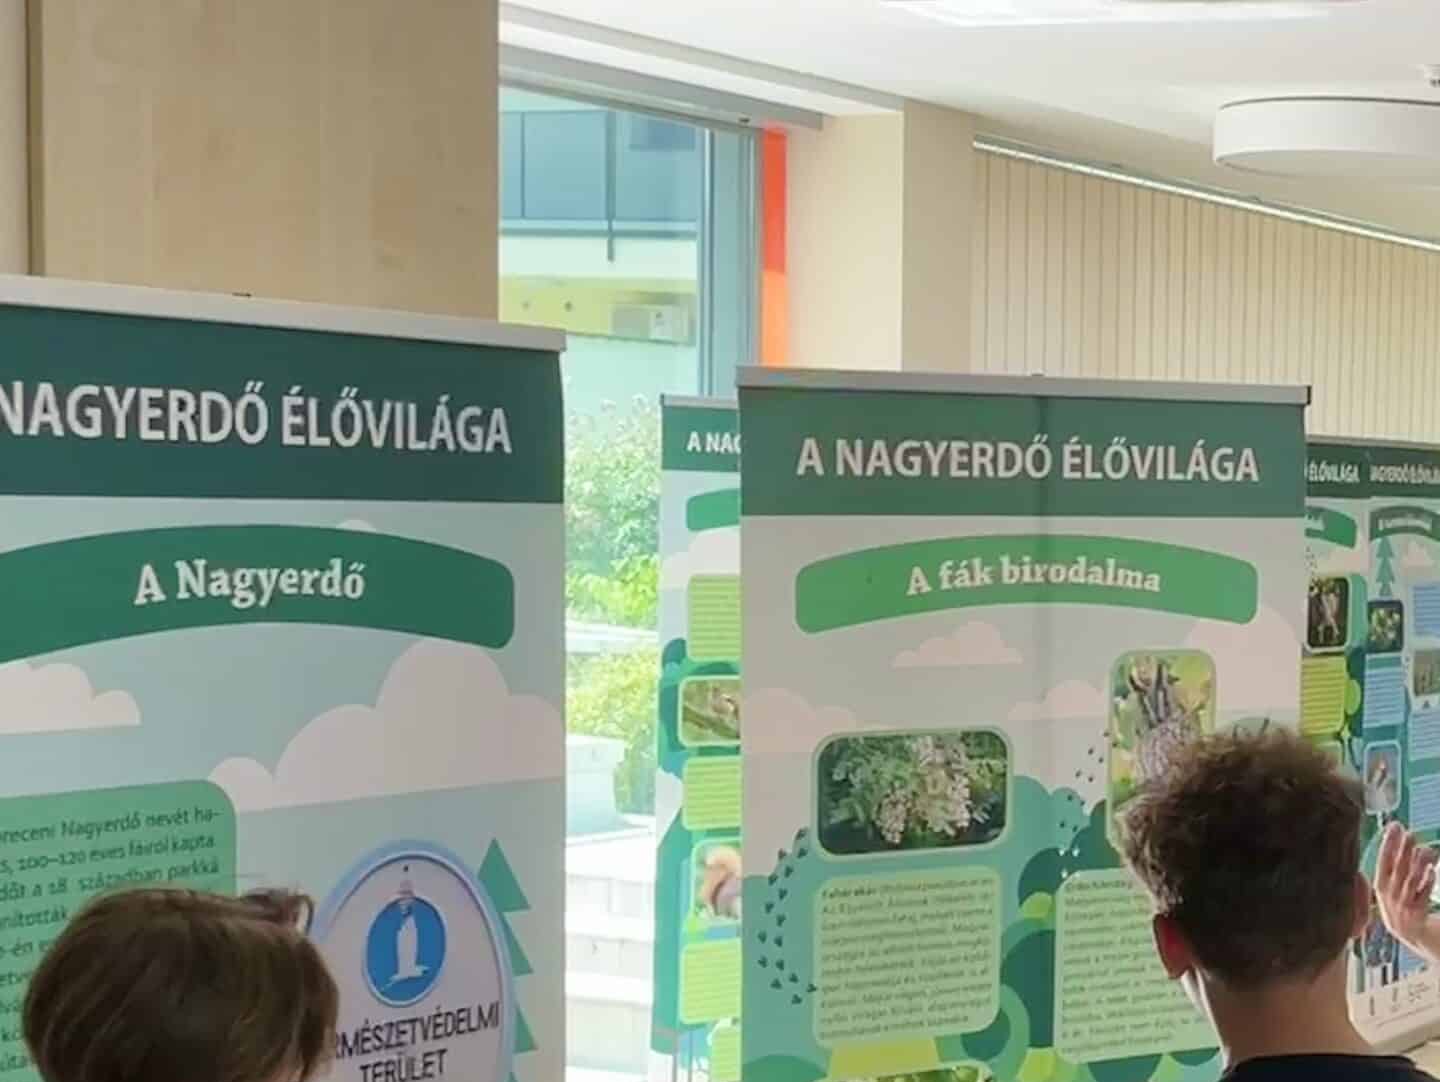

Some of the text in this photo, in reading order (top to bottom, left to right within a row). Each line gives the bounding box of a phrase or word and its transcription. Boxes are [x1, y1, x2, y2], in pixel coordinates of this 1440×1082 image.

[0, 380, 513, 454] NAGYERDŐ ÉLŐVILÁGA
[686, 431, 701, 453] A
[796, 433, 1260, 482] A NAGYERDŐ ÉLŐVILÁGA
[134, 558, 366, 610] A Nagyerdő
[906, 556, 1161, 596] A fák birodalma
[61, 811, 141, 840] Nagyerdő
[145, 808, 189, 827] nevét
[171, 834, 215, 853] kapta
[167, 859, 220, 883] parkká
